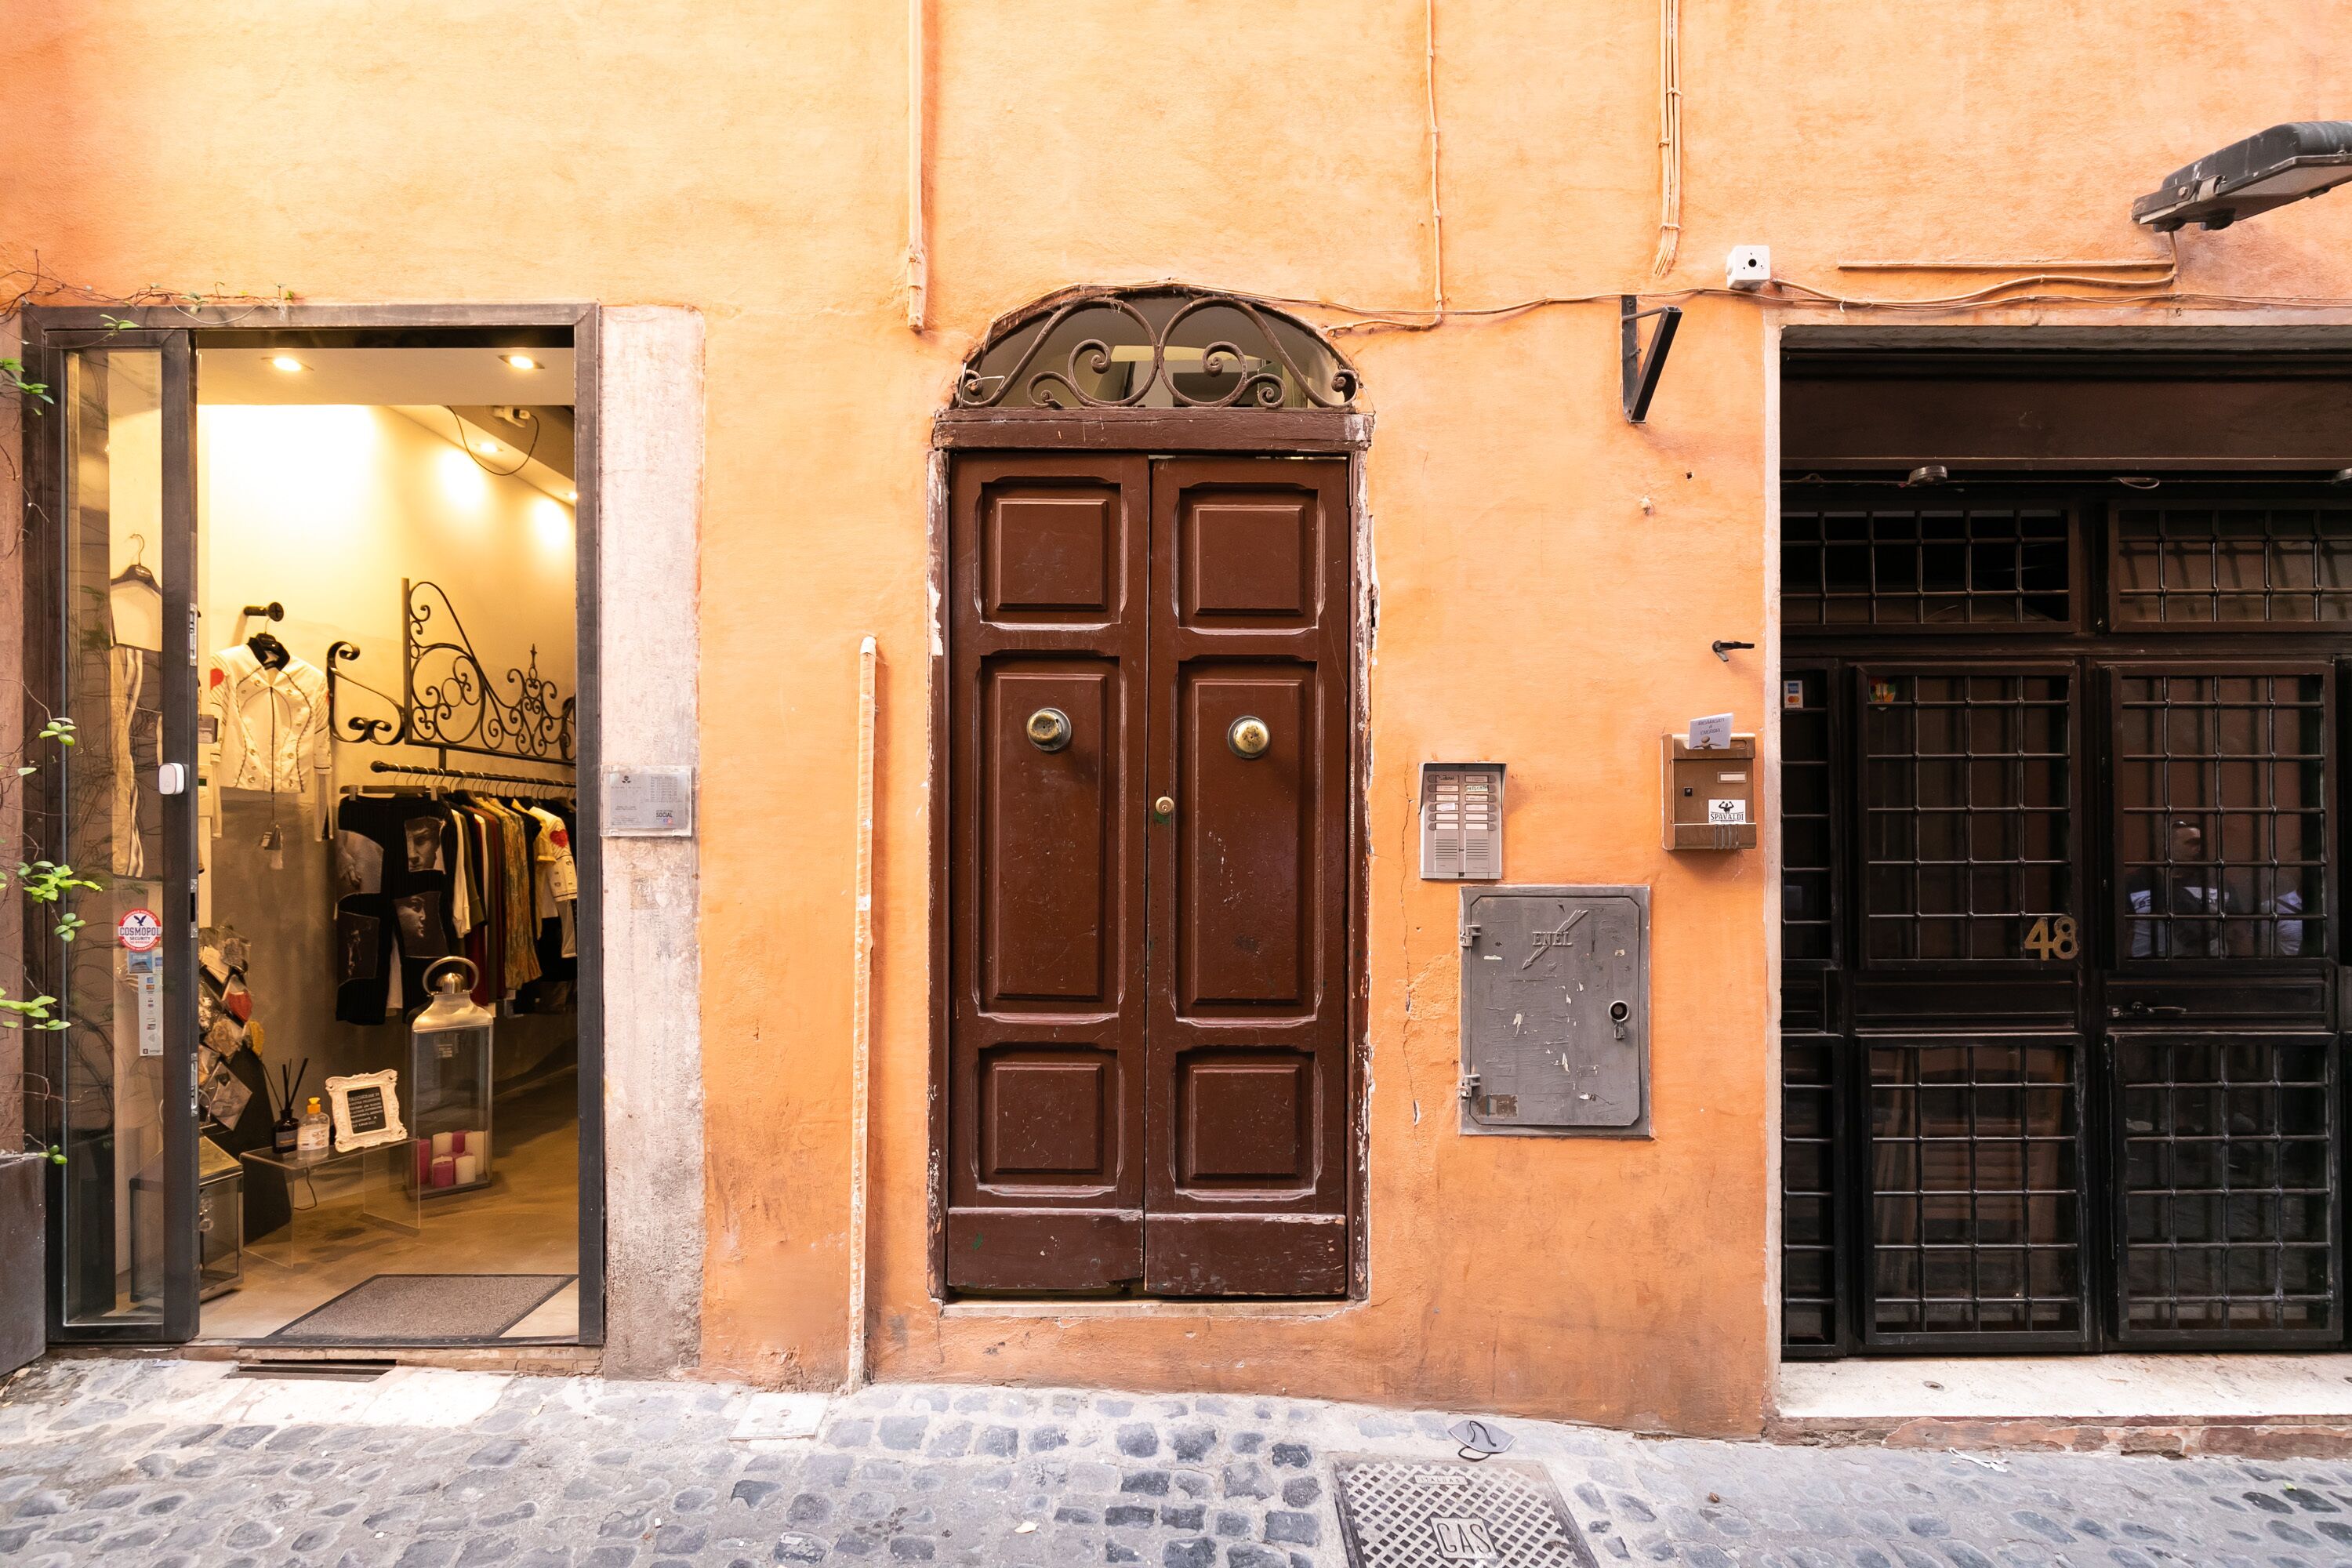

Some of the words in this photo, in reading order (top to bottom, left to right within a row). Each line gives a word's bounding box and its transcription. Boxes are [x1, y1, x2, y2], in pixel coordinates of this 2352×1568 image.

[120, 927, 161, 936] COSMOPOL
[1532, 931, 1573, 947] ENEL
[2024, 916, 2078, 961] 48
[1436, 1523, 1491, 1554] GAS
